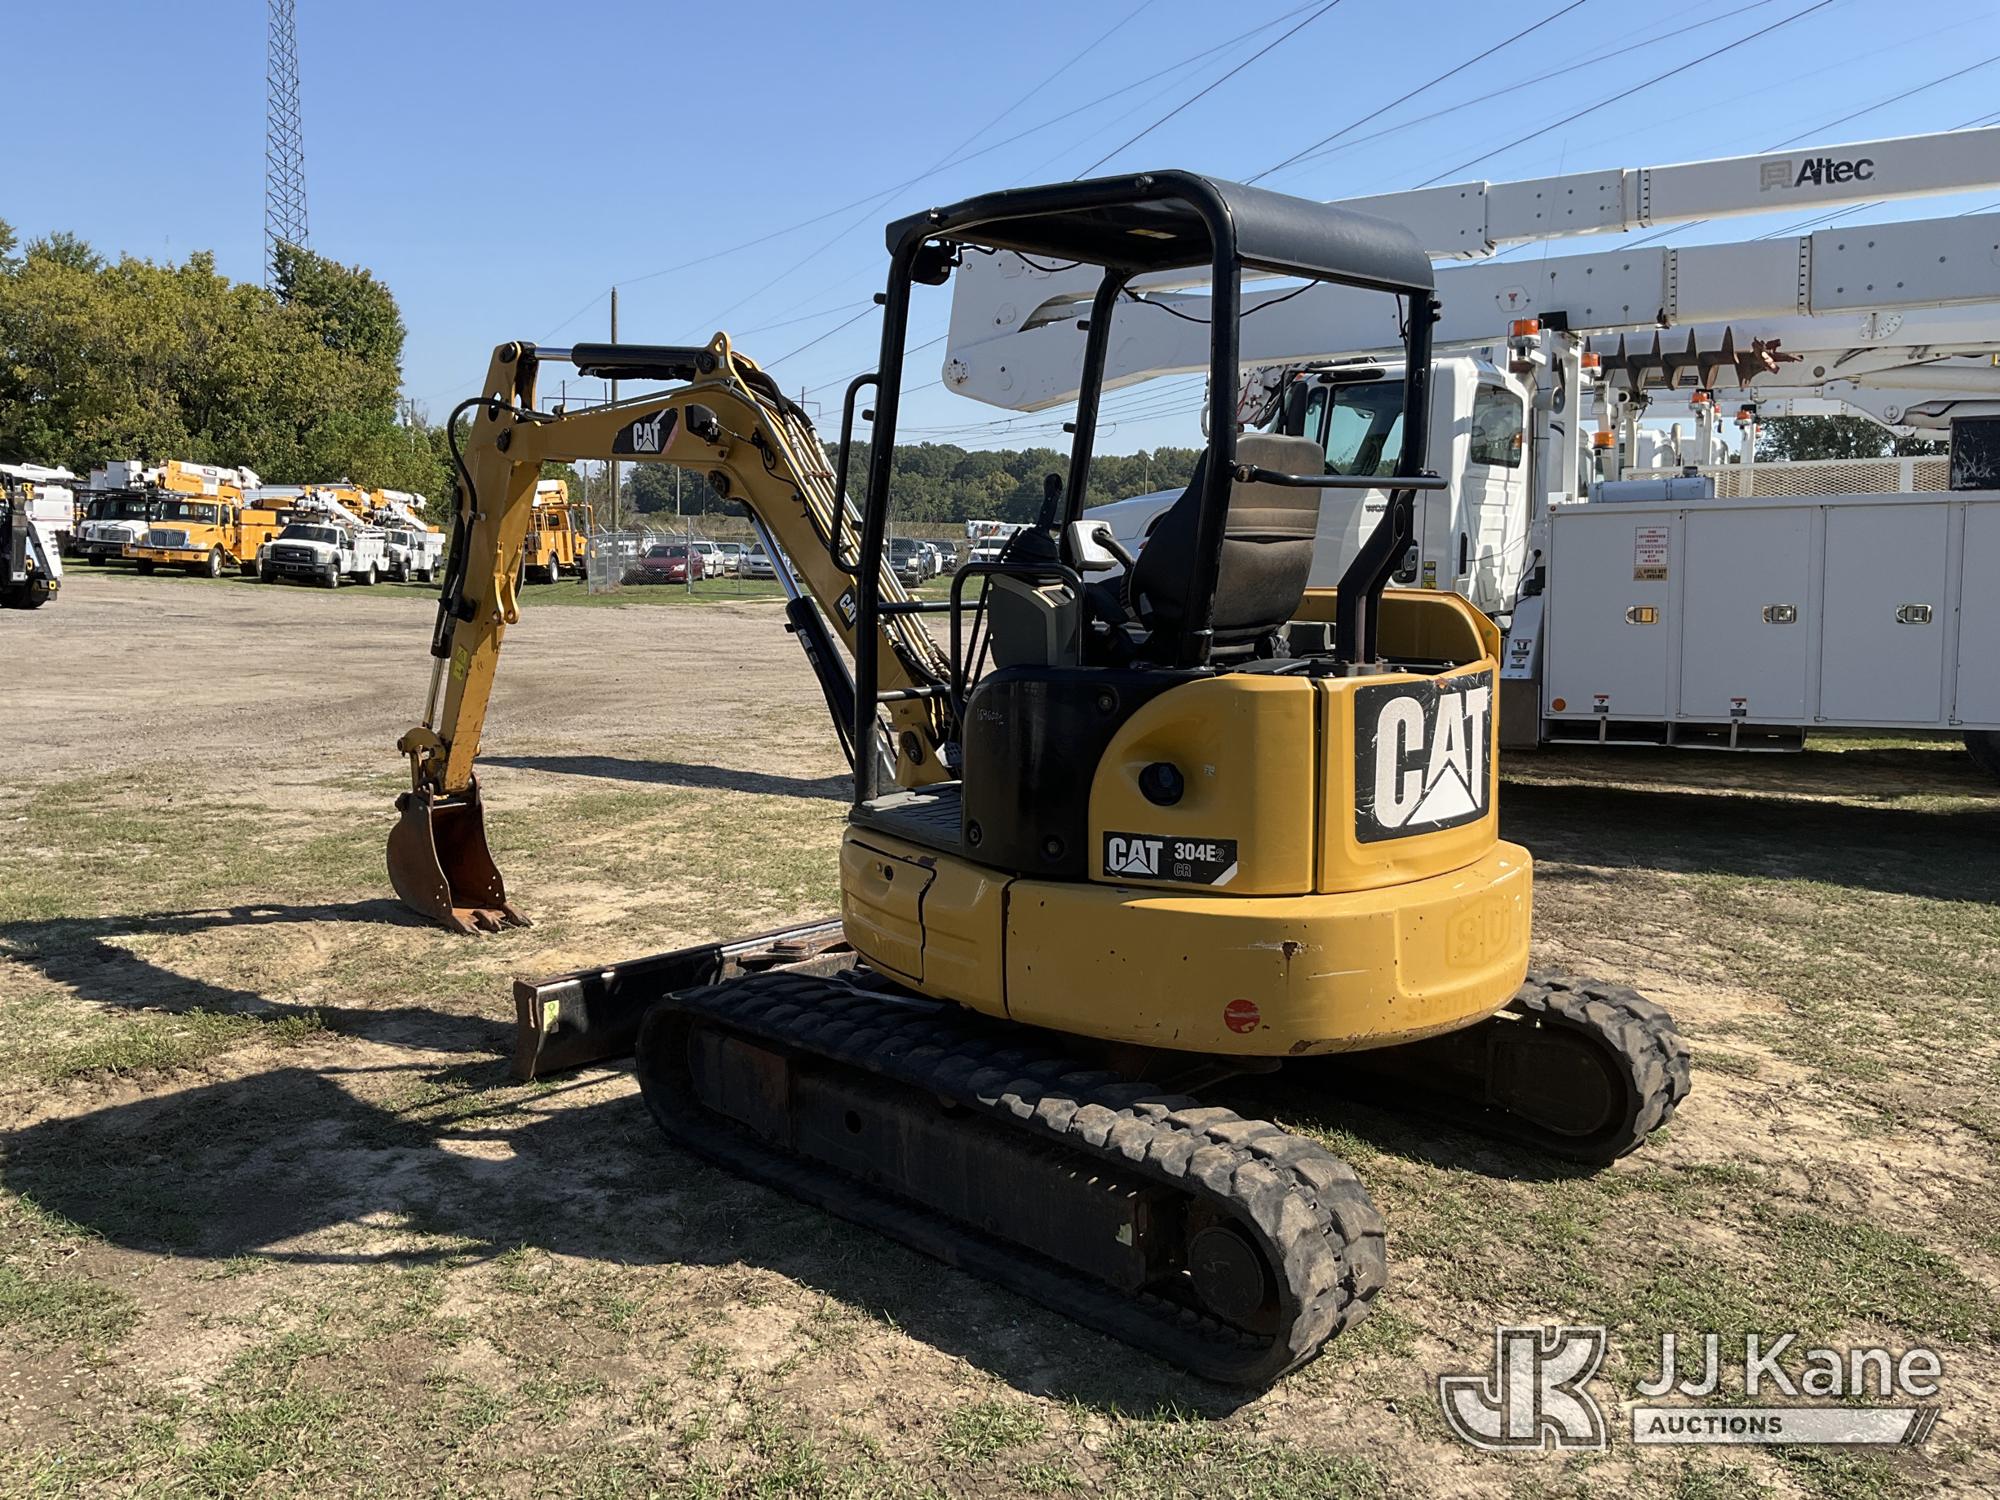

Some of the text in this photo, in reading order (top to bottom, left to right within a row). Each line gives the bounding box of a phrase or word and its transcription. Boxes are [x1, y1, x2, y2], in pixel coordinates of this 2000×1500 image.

[1794, 157, 1875, 188] Altec
[633, 422, 660, 451] CAT
[1374, 686, 1488, 828] CAT
[1108, 837, 1225, 876] CAT 304E2
[1173, 862, 1192, 877] CR
